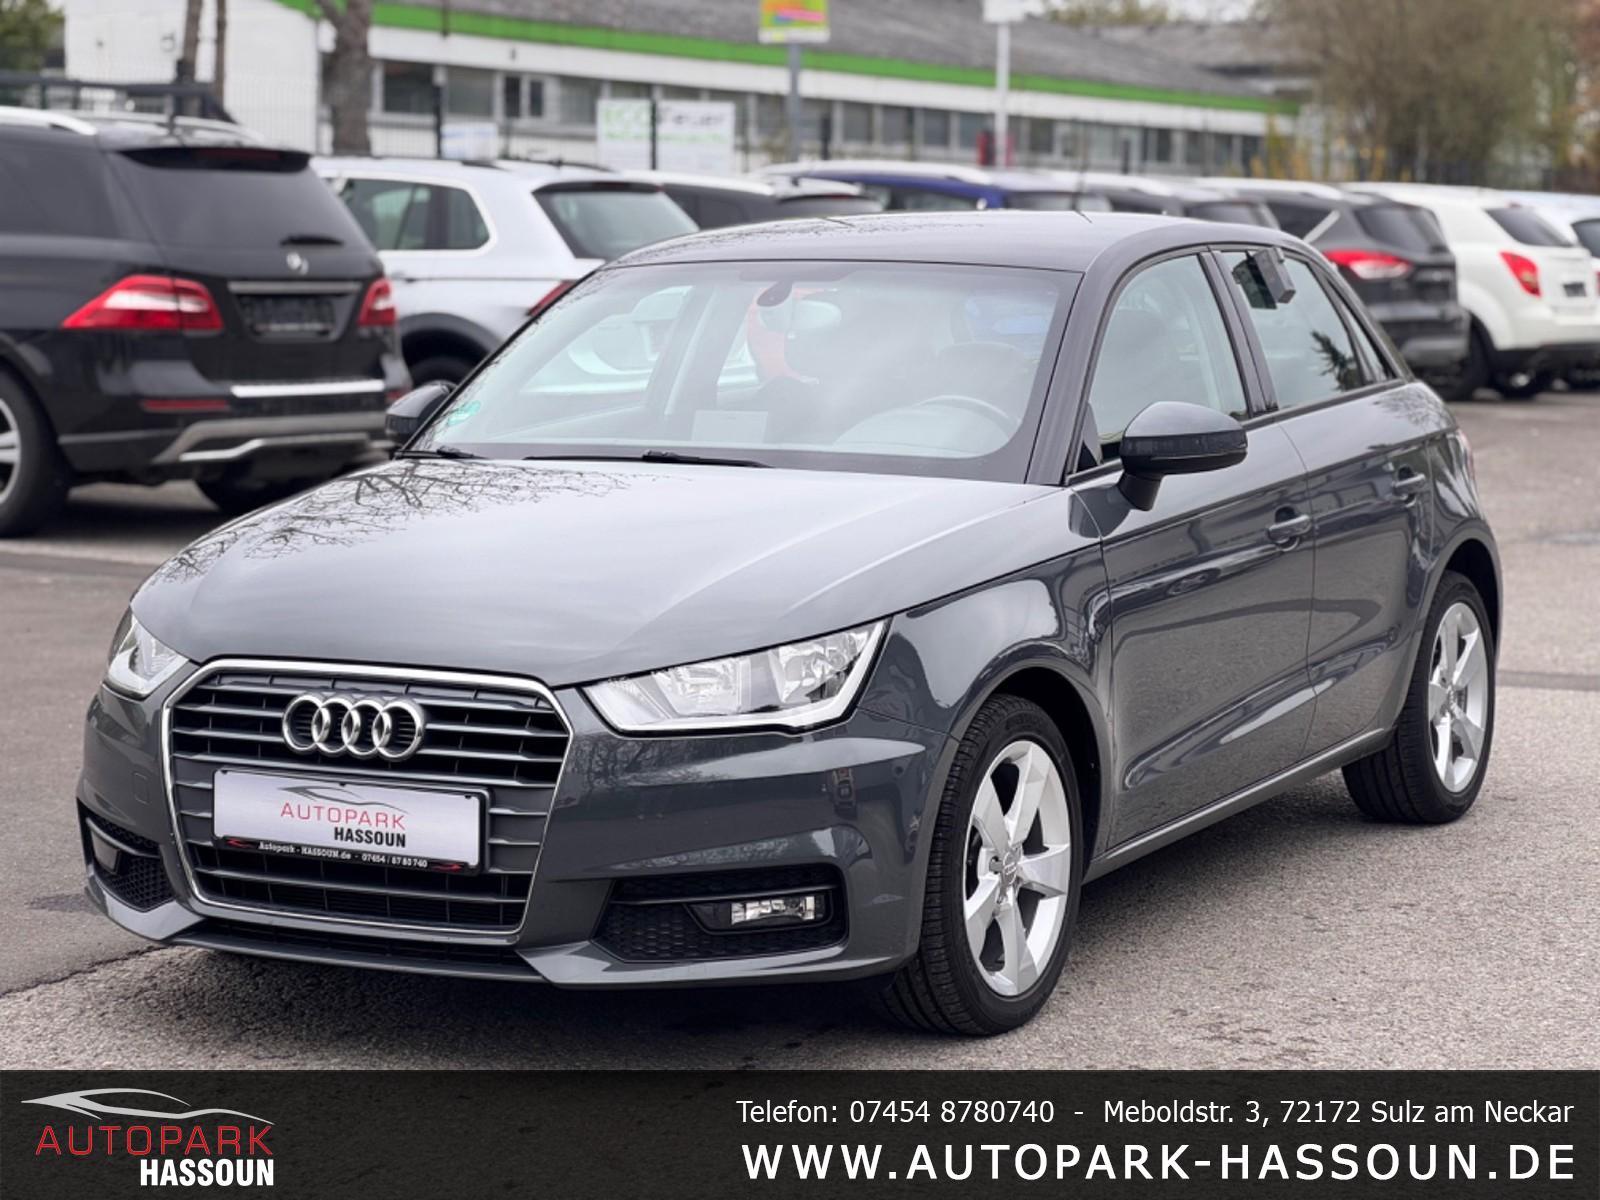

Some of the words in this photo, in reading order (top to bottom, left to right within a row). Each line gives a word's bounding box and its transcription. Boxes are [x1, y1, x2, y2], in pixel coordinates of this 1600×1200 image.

[280, 802, 406, 830] AUTOPARK
[334, 826, 406, 848] HASSOUN
[259, 841, 296, 854] Autopark
[301, 846, 352, 860] HASSOUN.de
[361, 852, 386, 864] 07454
